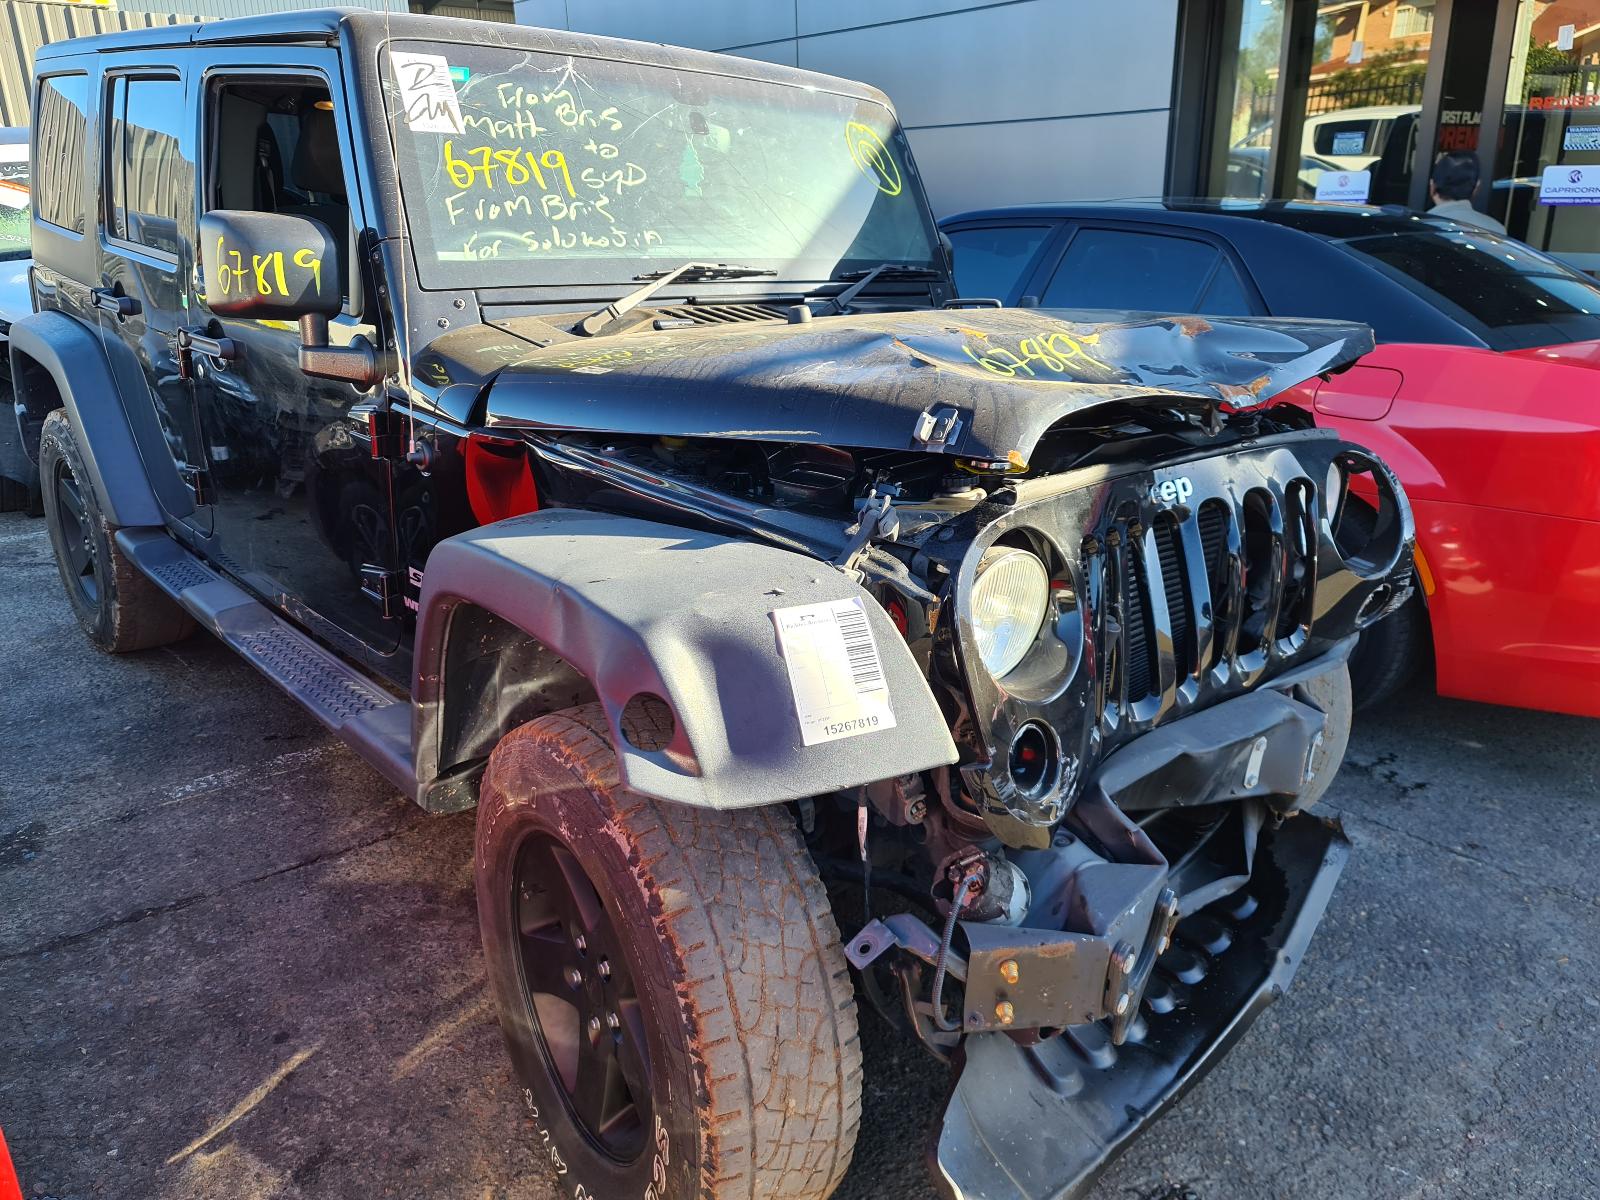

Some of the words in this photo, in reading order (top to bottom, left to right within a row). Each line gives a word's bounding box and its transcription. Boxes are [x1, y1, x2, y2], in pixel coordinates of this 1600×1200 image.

[444, 140, 576, 198] 67819
[216, 236, 321, 296] 67819
[823, 715, 879, 736] 15267819
